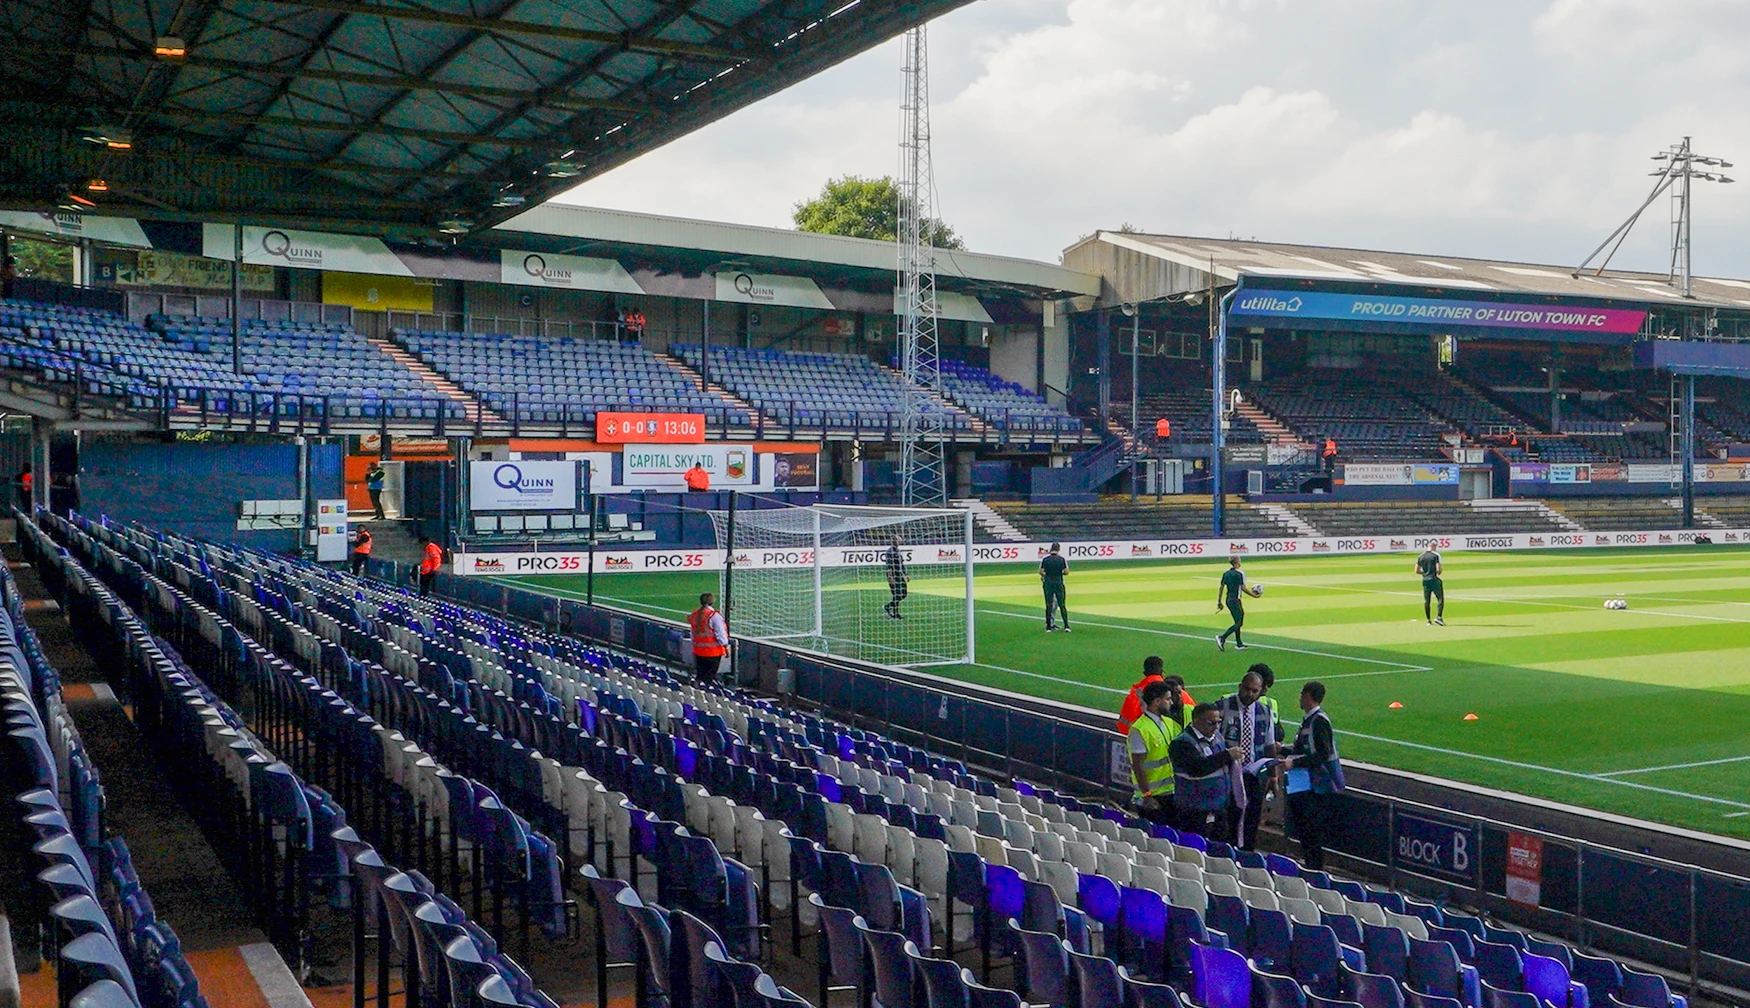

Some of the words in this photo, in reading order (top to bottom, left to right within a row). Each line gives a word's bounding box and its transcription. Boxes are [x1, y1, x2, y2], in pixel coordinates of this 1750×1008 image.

[262, 230, 323, 260] QUINN
[523, 254, 572, 280] QUINN
[734, 273, 775, 297] QUINN
[1240, 297, 1287, 311] utilita
[1351, 302, 1405, 316] PROUD
[1407, 304, 1473, 320] PARTNER
[1474, 308, 1498, 321] OF
[1496, 309, 1544, 323] LUTON
[1545, 312, 1588, 326] TOWN
[1587, 314, 1606, 327] FC
[622, 421, 644, 434] 0-0
[665, 421, 697, 434] 13:06
[629, 454, 671, 468] CAPITAL
[675, 454, 693, 467] SKY
[493, 463, 554, 493] QUINN
[1337, 539, 1375, 550] PRO35
[1466, 536, 1514, 548] TENGTOOLS
[1551, 535, 1583, 545] PRO35
[1616, 534, 1648, 543] PRO35
[973, 547, 1018, 560] PRO35
[1069, 545, 1114, 557] PRO35
[1161, 543, 1203, 555] PRO35
[1256, 541, 1296, 552] PRO35
[517, 556, 580, 570] PRO35
[645, 554, 703, 568] PRO35
[1400, 836, 1441, 864] BLOCK
[1453, 831, 1469, 871] B
